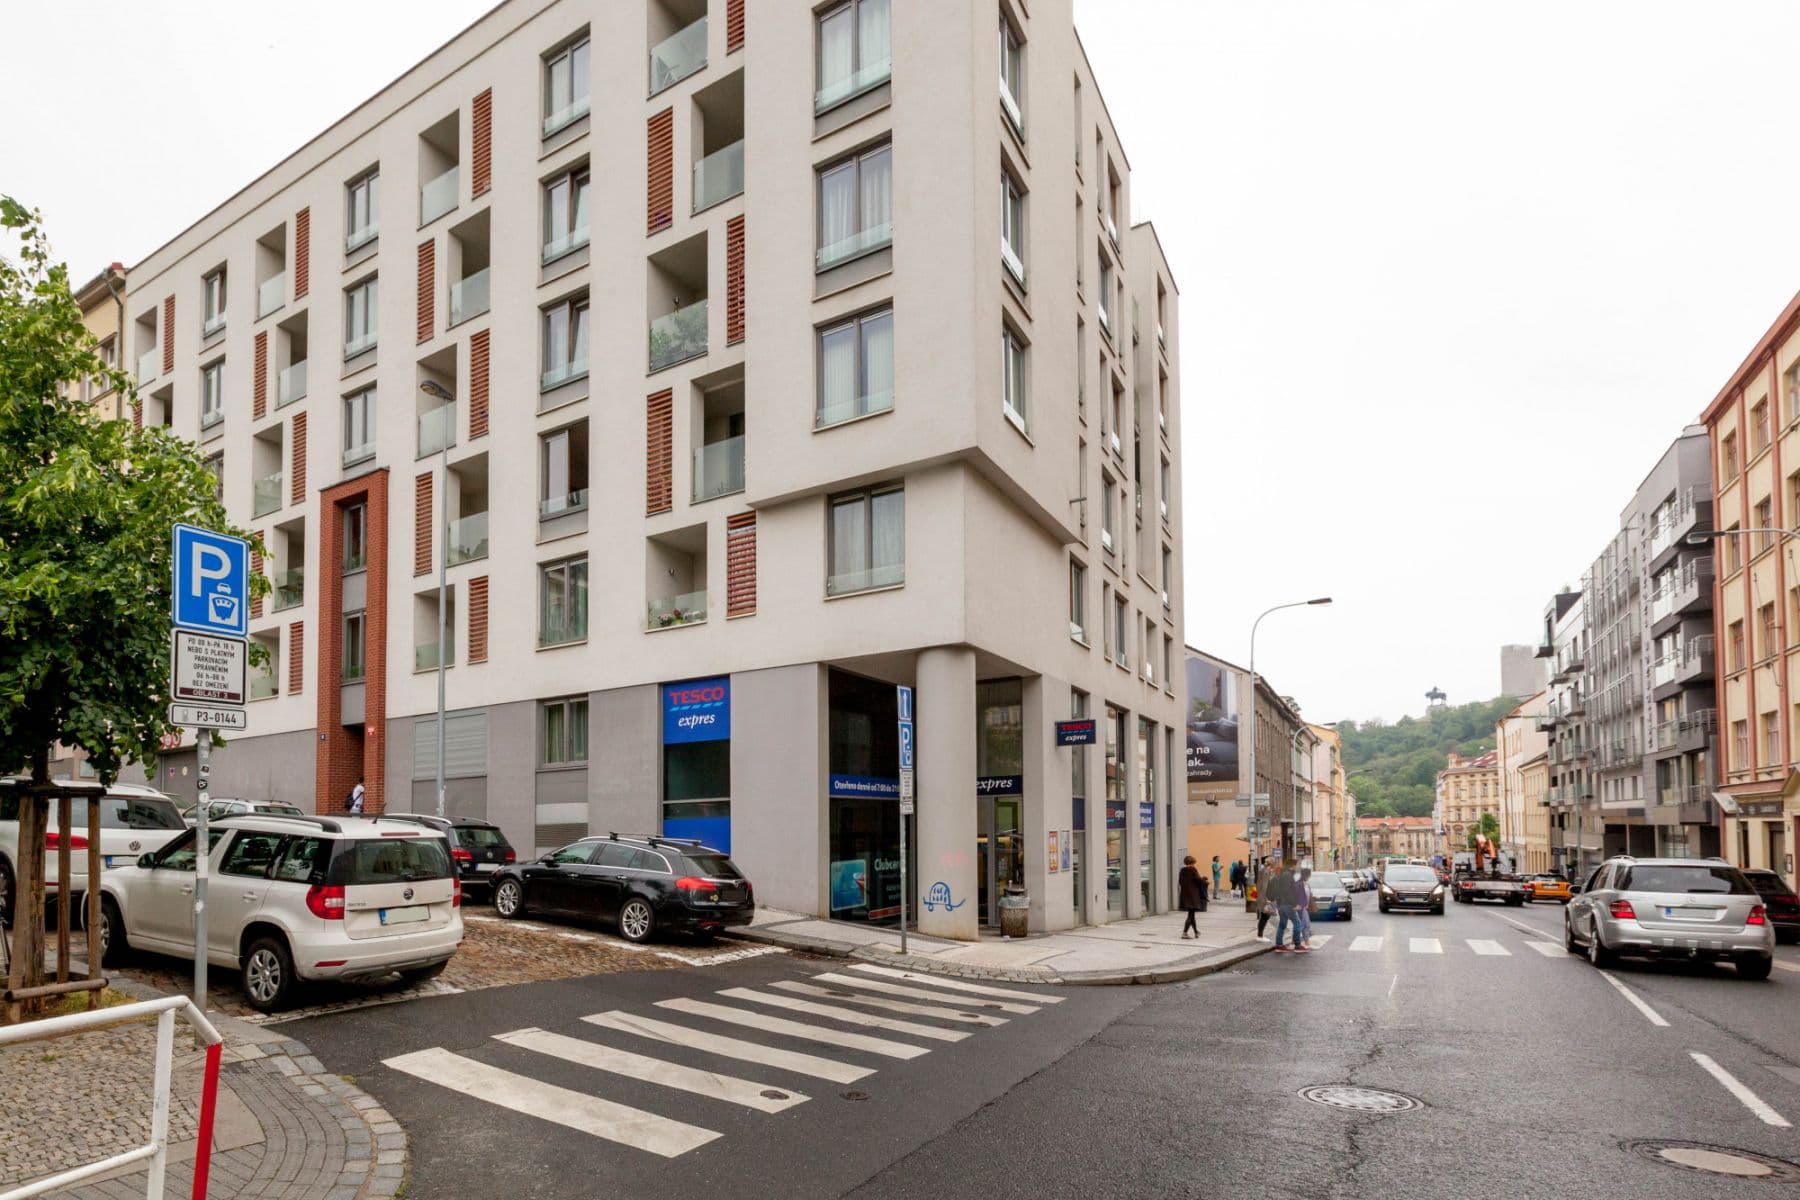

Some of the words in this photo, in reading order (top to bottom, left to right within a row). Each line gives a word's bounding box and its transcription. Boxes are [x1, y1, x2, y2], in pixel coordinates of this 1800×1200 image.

[191, 541, 232, 597] P
[187, 646, 203, 654] NEBO
[192, 689, 220, 698] OBLAST
[669, 686, 725, 705] TESCO
[196, 710, 237, 724] P3-0144
[678, 713, 716, 729] expres
[902, 727, 910, 752] P
[1065, 734, 1088, 743] expres
[1196, 746, 1210, 754] na
